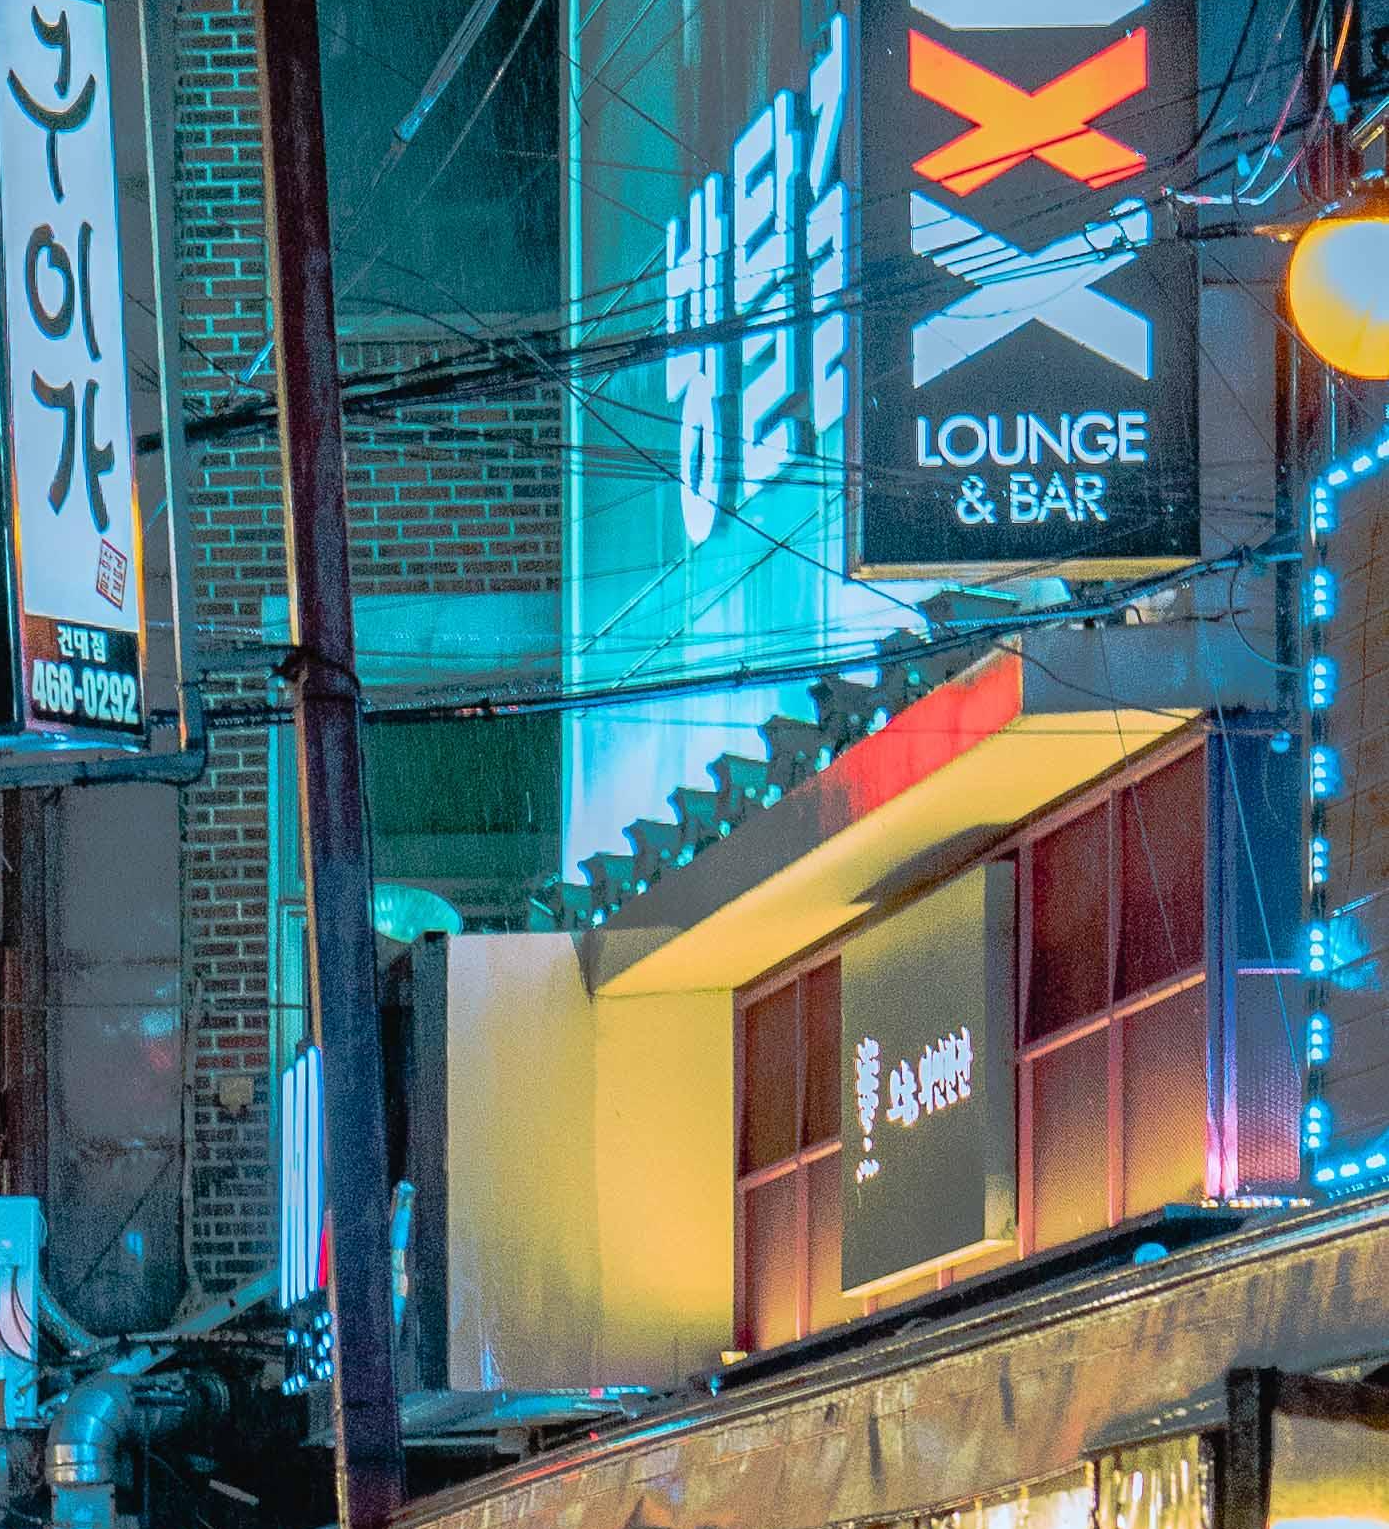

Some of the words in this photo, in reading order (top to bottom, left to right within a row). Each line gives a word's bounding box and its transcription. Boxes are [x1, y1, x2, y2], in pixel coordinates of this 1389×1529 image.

[917, 412, 1148, 468] LOUNGE
[957, 476, 998, 526] &
[1010, 472, 1107, 523] BAR
[32, 659, 140, 725] 468-0292
